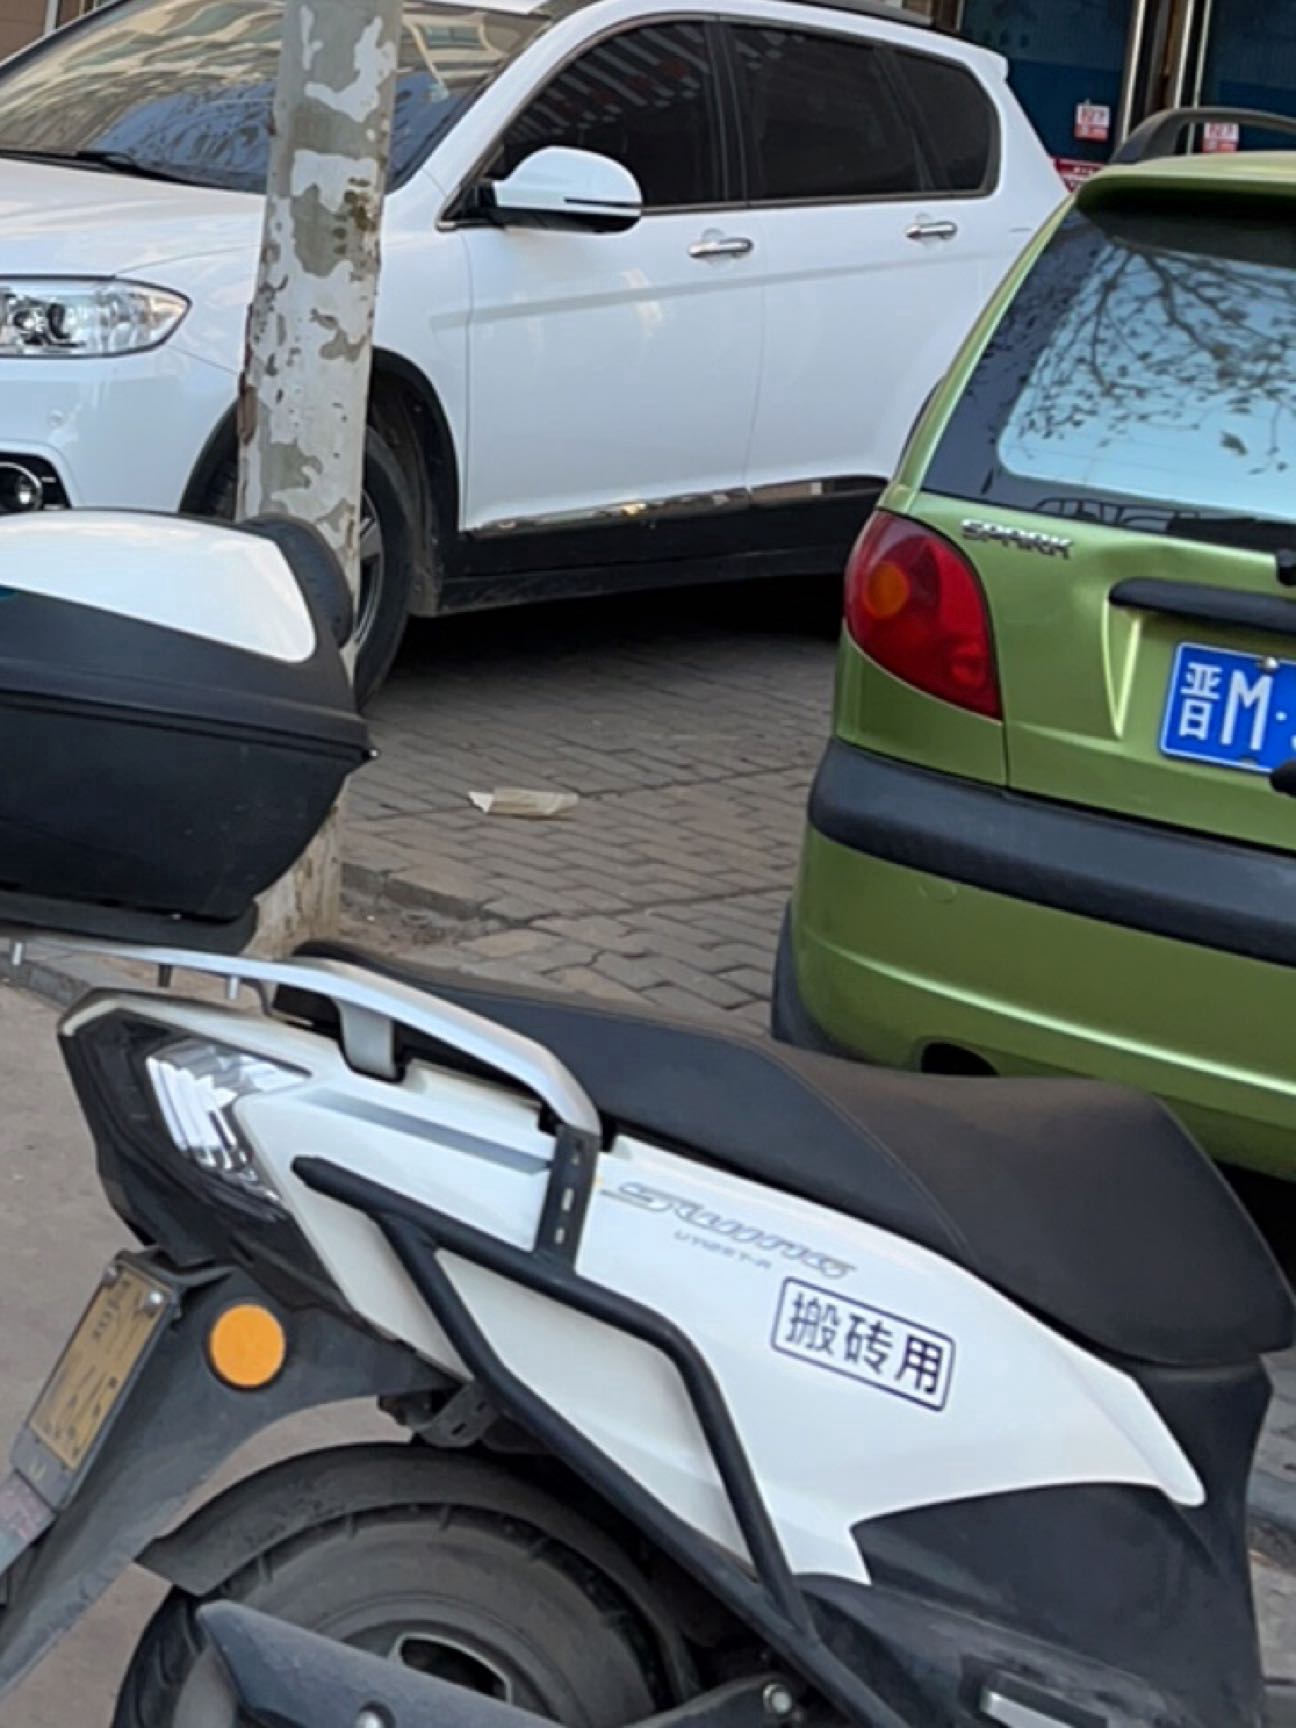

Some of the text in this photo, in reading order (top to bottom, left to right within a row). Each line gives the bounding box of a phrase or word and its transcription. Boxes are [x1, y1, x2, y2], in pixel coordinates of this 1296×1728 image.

[1178, 661, 1296, 752] 晋M
[784, 1291, 945, 1395] 搬砖用
